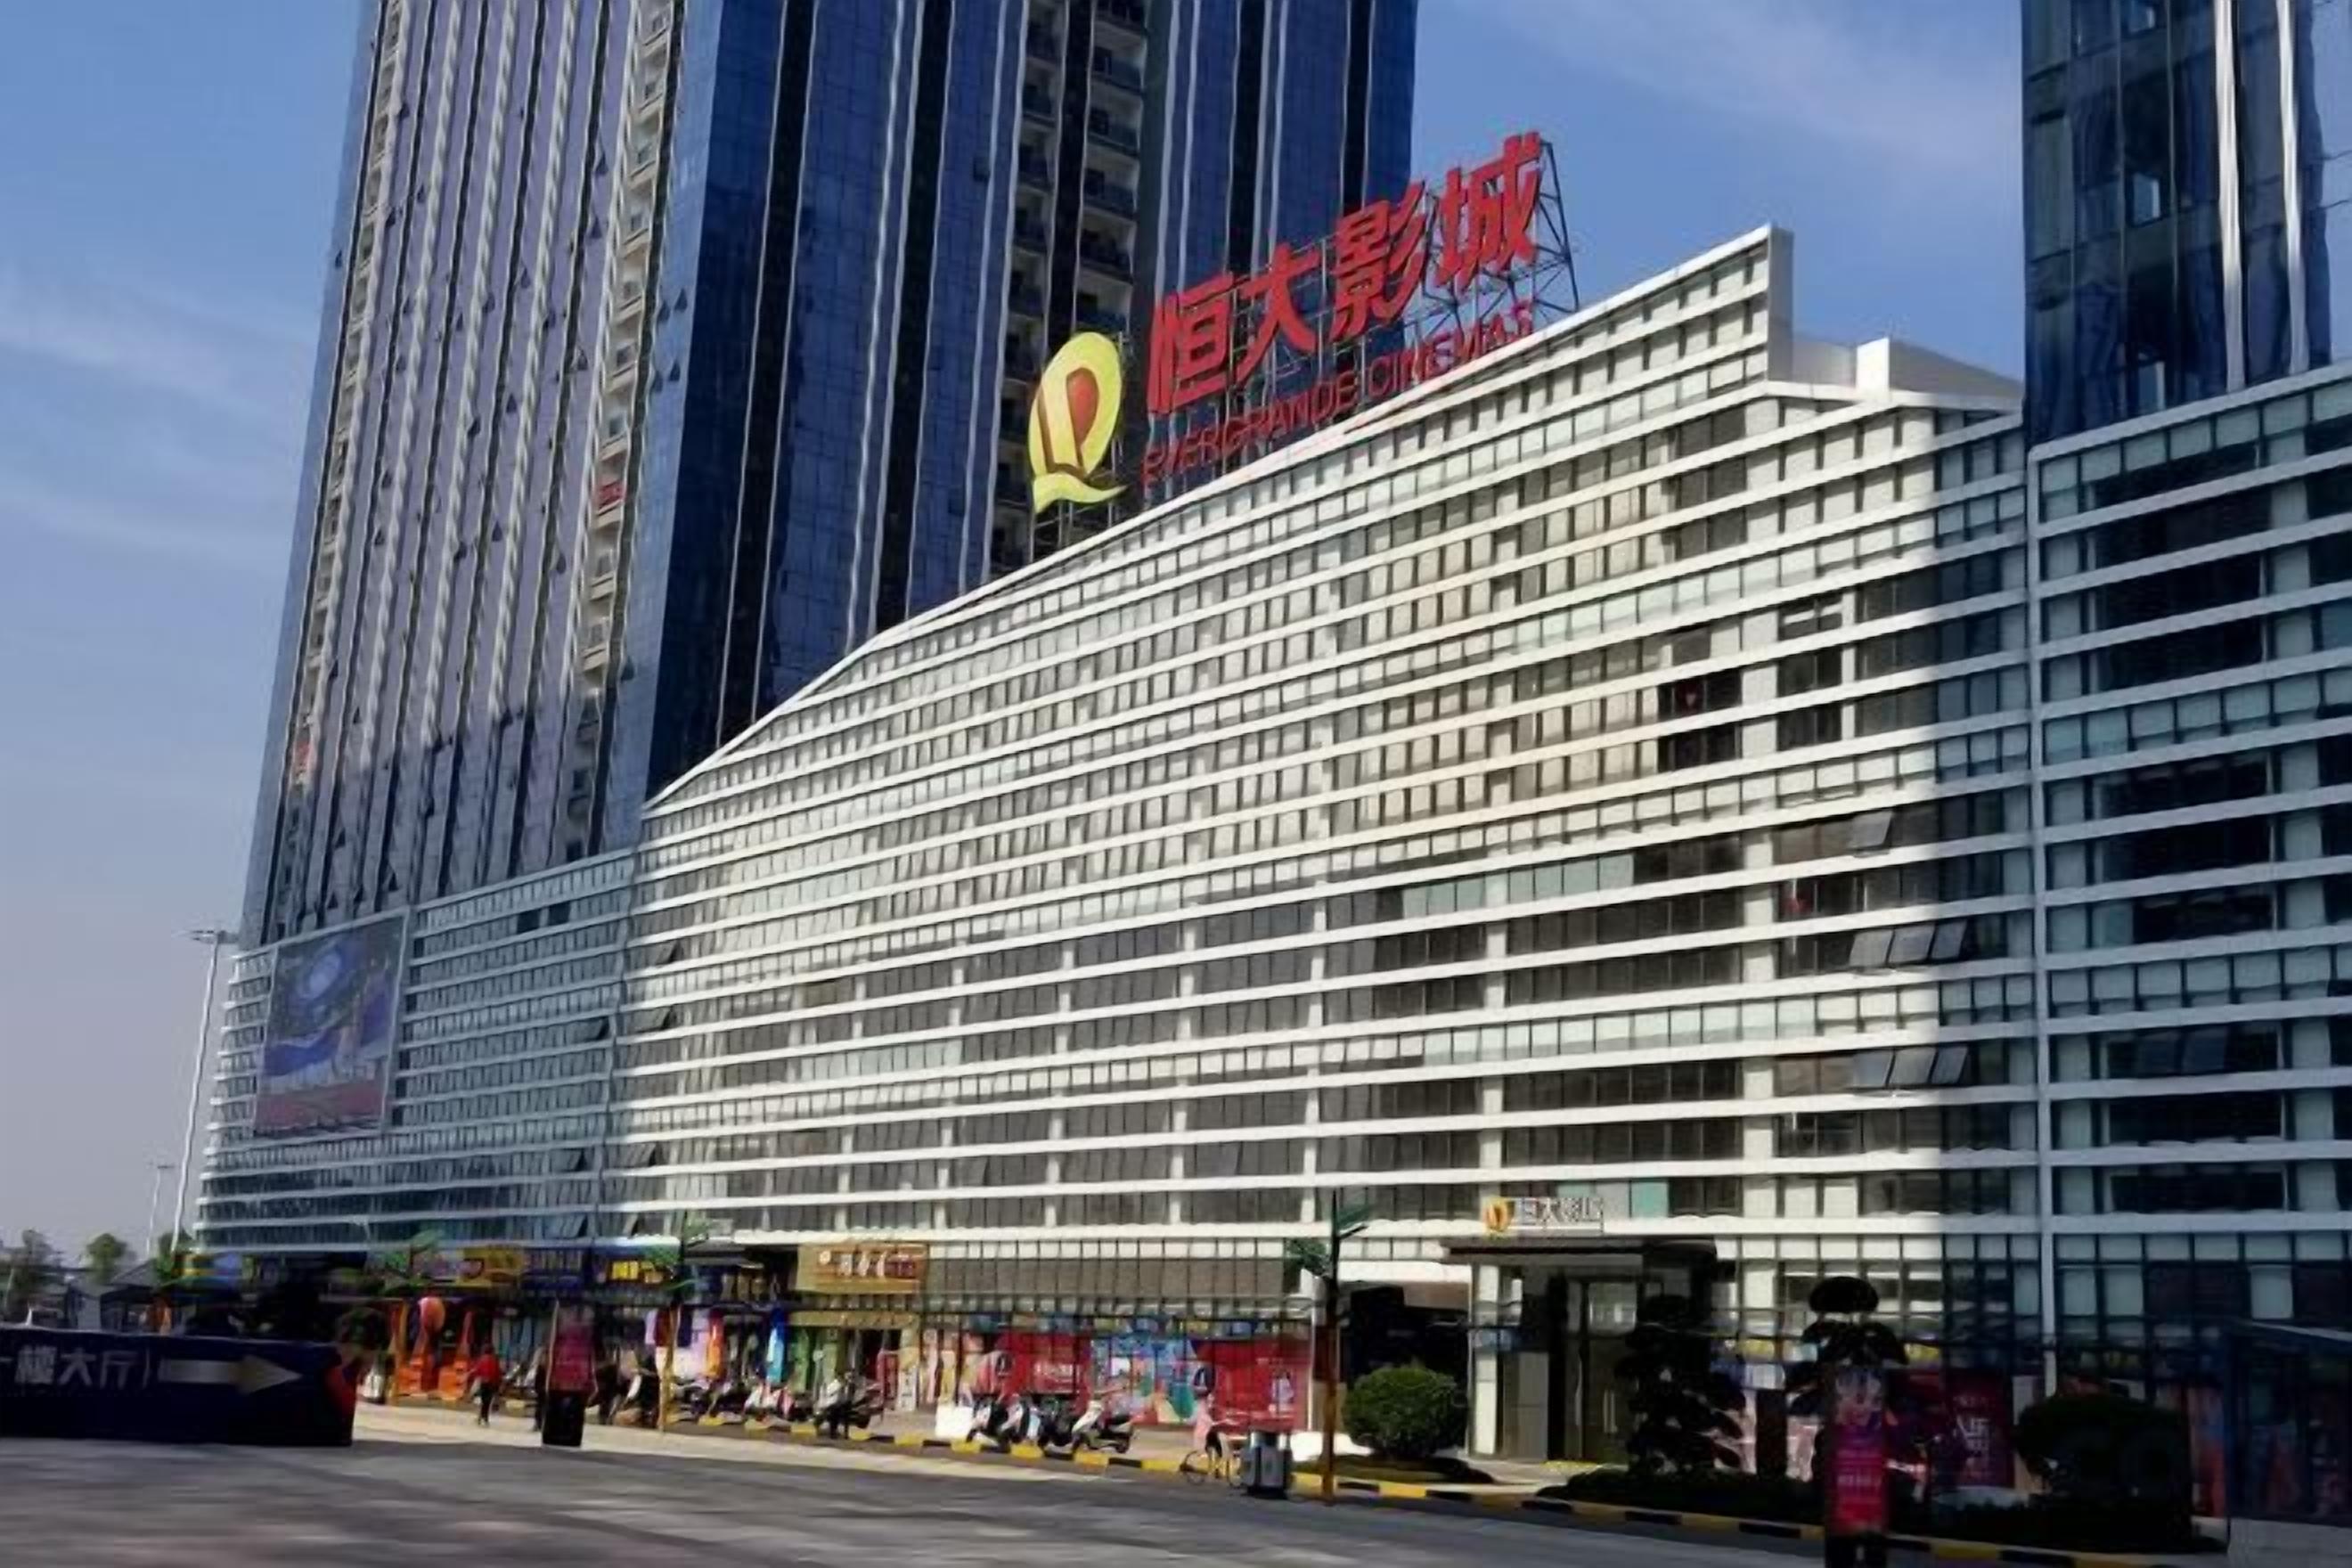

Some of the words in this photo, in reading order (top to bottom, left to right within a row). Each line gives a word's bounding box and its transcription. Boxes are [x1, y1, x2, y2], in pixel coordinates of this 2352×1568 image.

[1146, 131, 1541, 413] 恒大影城
[1140, 368, 1361, 486] EVERGRANDE
[1367, 298, 1534, 397] CINEMAS
